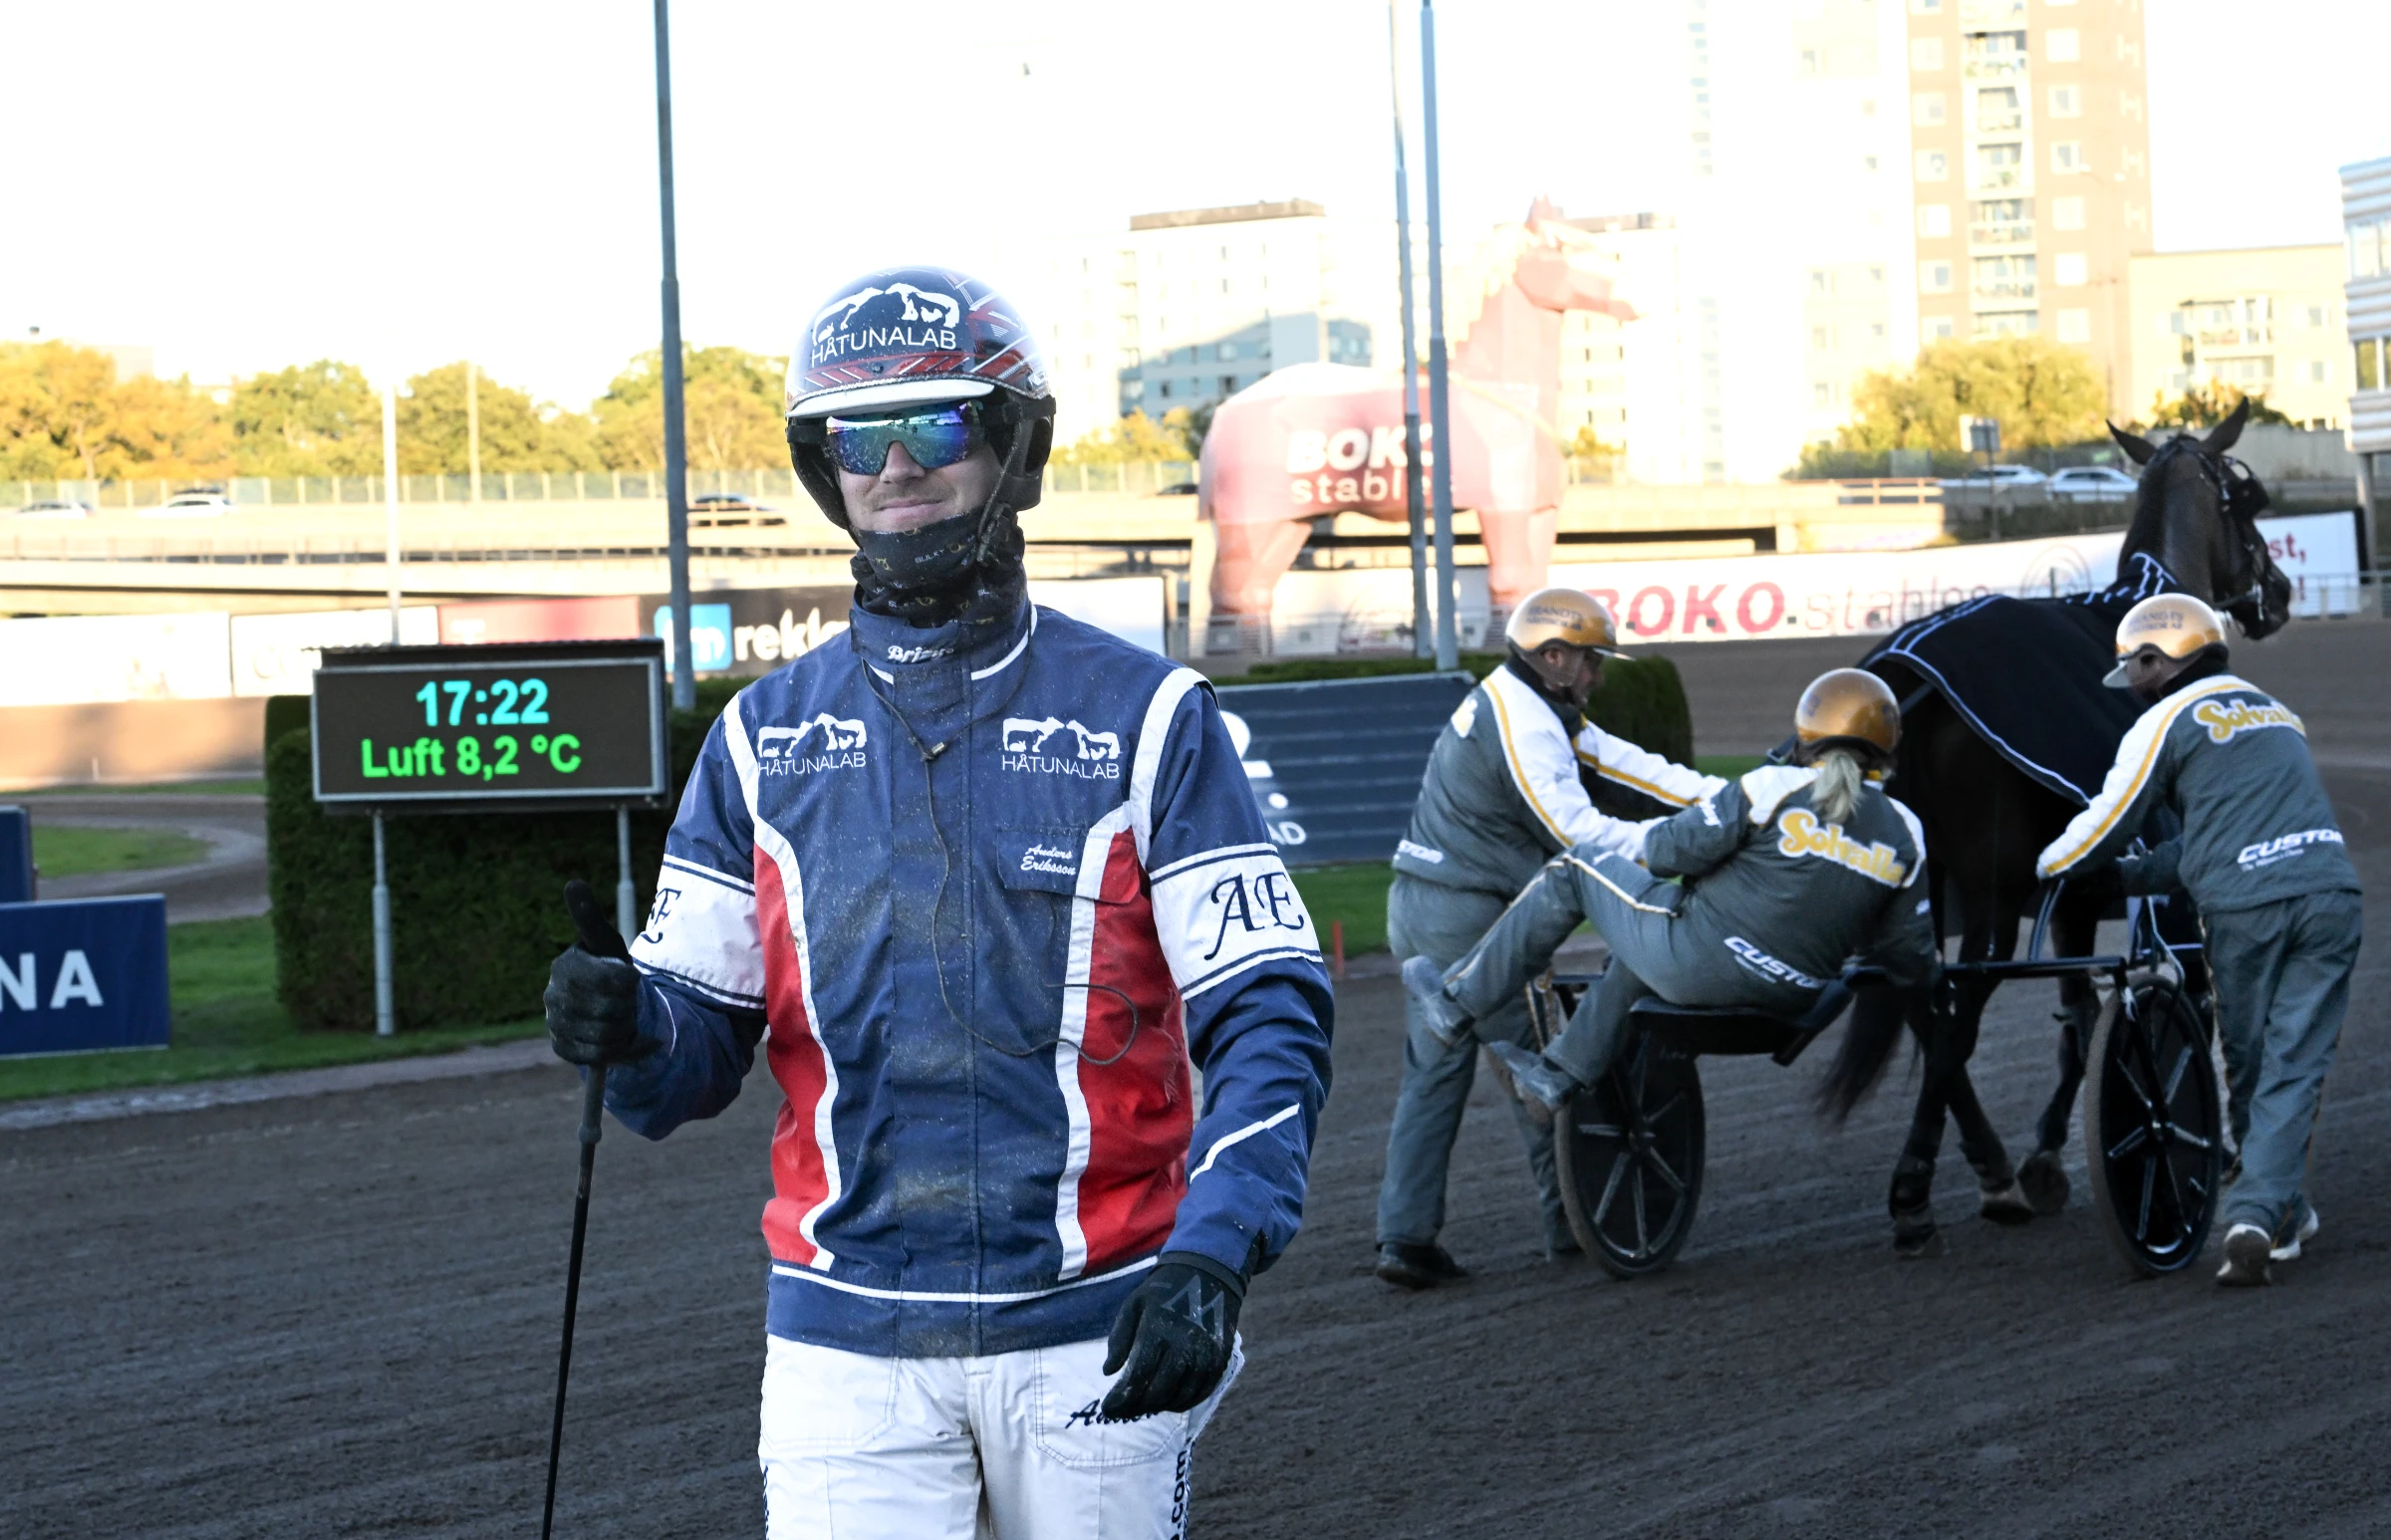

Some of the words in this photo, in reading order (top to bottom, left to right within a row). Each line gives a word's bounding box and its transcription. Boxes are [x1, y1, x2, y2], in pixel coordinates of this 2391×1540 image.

[811, 326, 957, 368] HÅTUNALAB
[415, 678, 550, 726] 17:22
[362, 738, 445, 777] Luft
[456, 735, 519, 781] 8,2
[531, 733, 581, 773] °C
[758, 752, 866, 777] HÅTUNALAB
[1001, 754, 1120, 779] HÅTUNALAB
[1025, 844, 1073, 860] Anders
[1020, 855, 1076, 876] Eriksson
